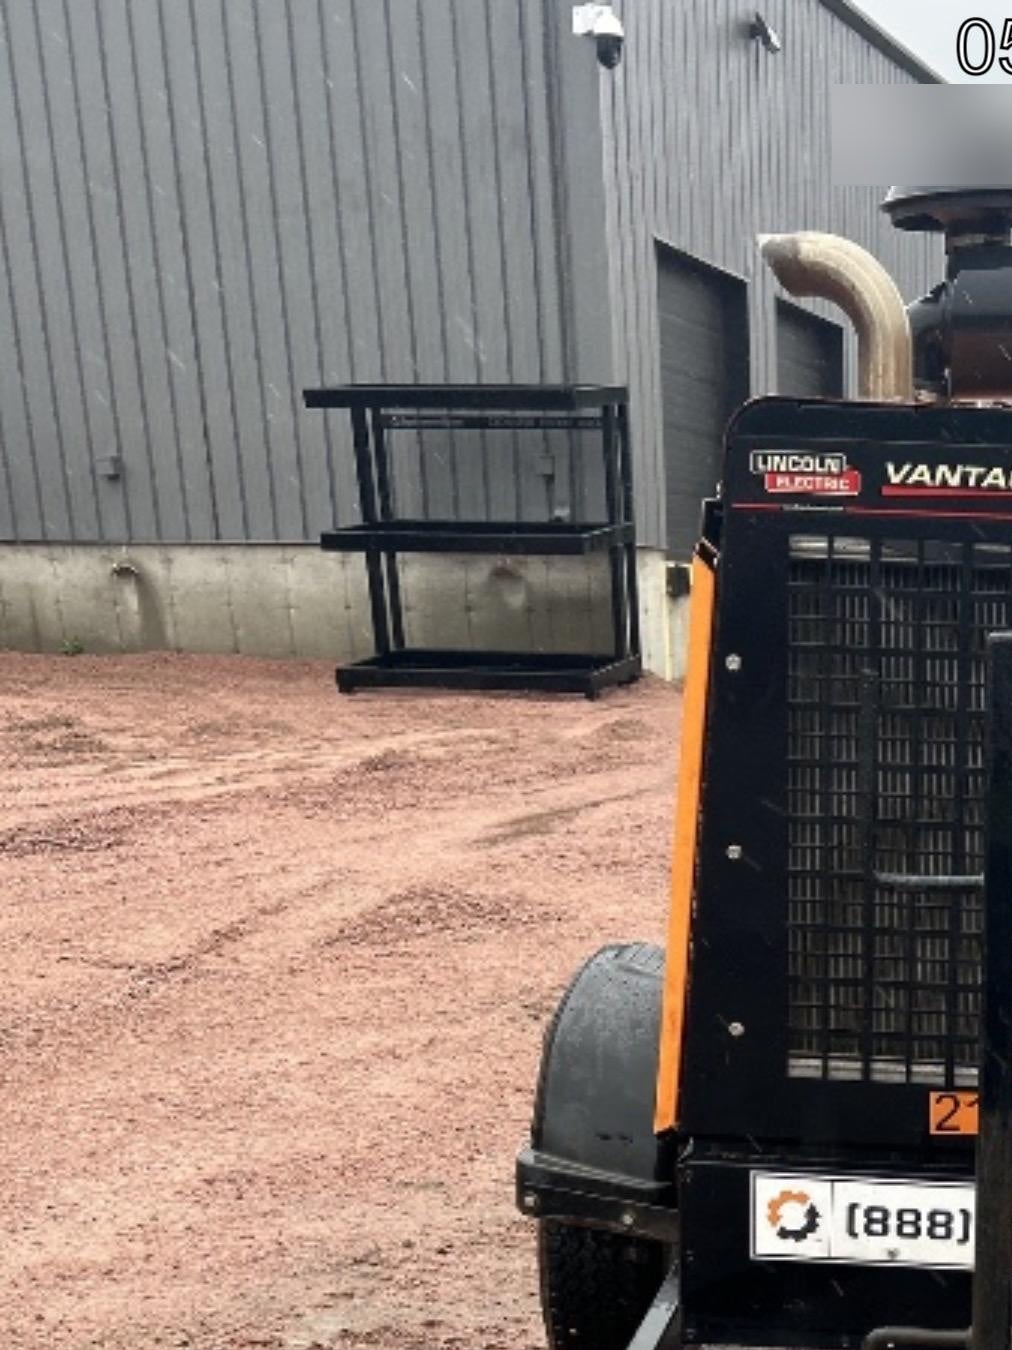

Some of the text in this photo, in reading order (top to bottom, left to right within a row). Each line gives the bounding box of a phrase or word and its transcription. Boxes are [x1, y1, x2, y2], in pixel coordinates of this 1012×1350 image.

[757, 454, 842, 473] LINCOLN
[775, 475, 851, 490] ELECTRIC
[846, 1204, 970, 1242] (888)
